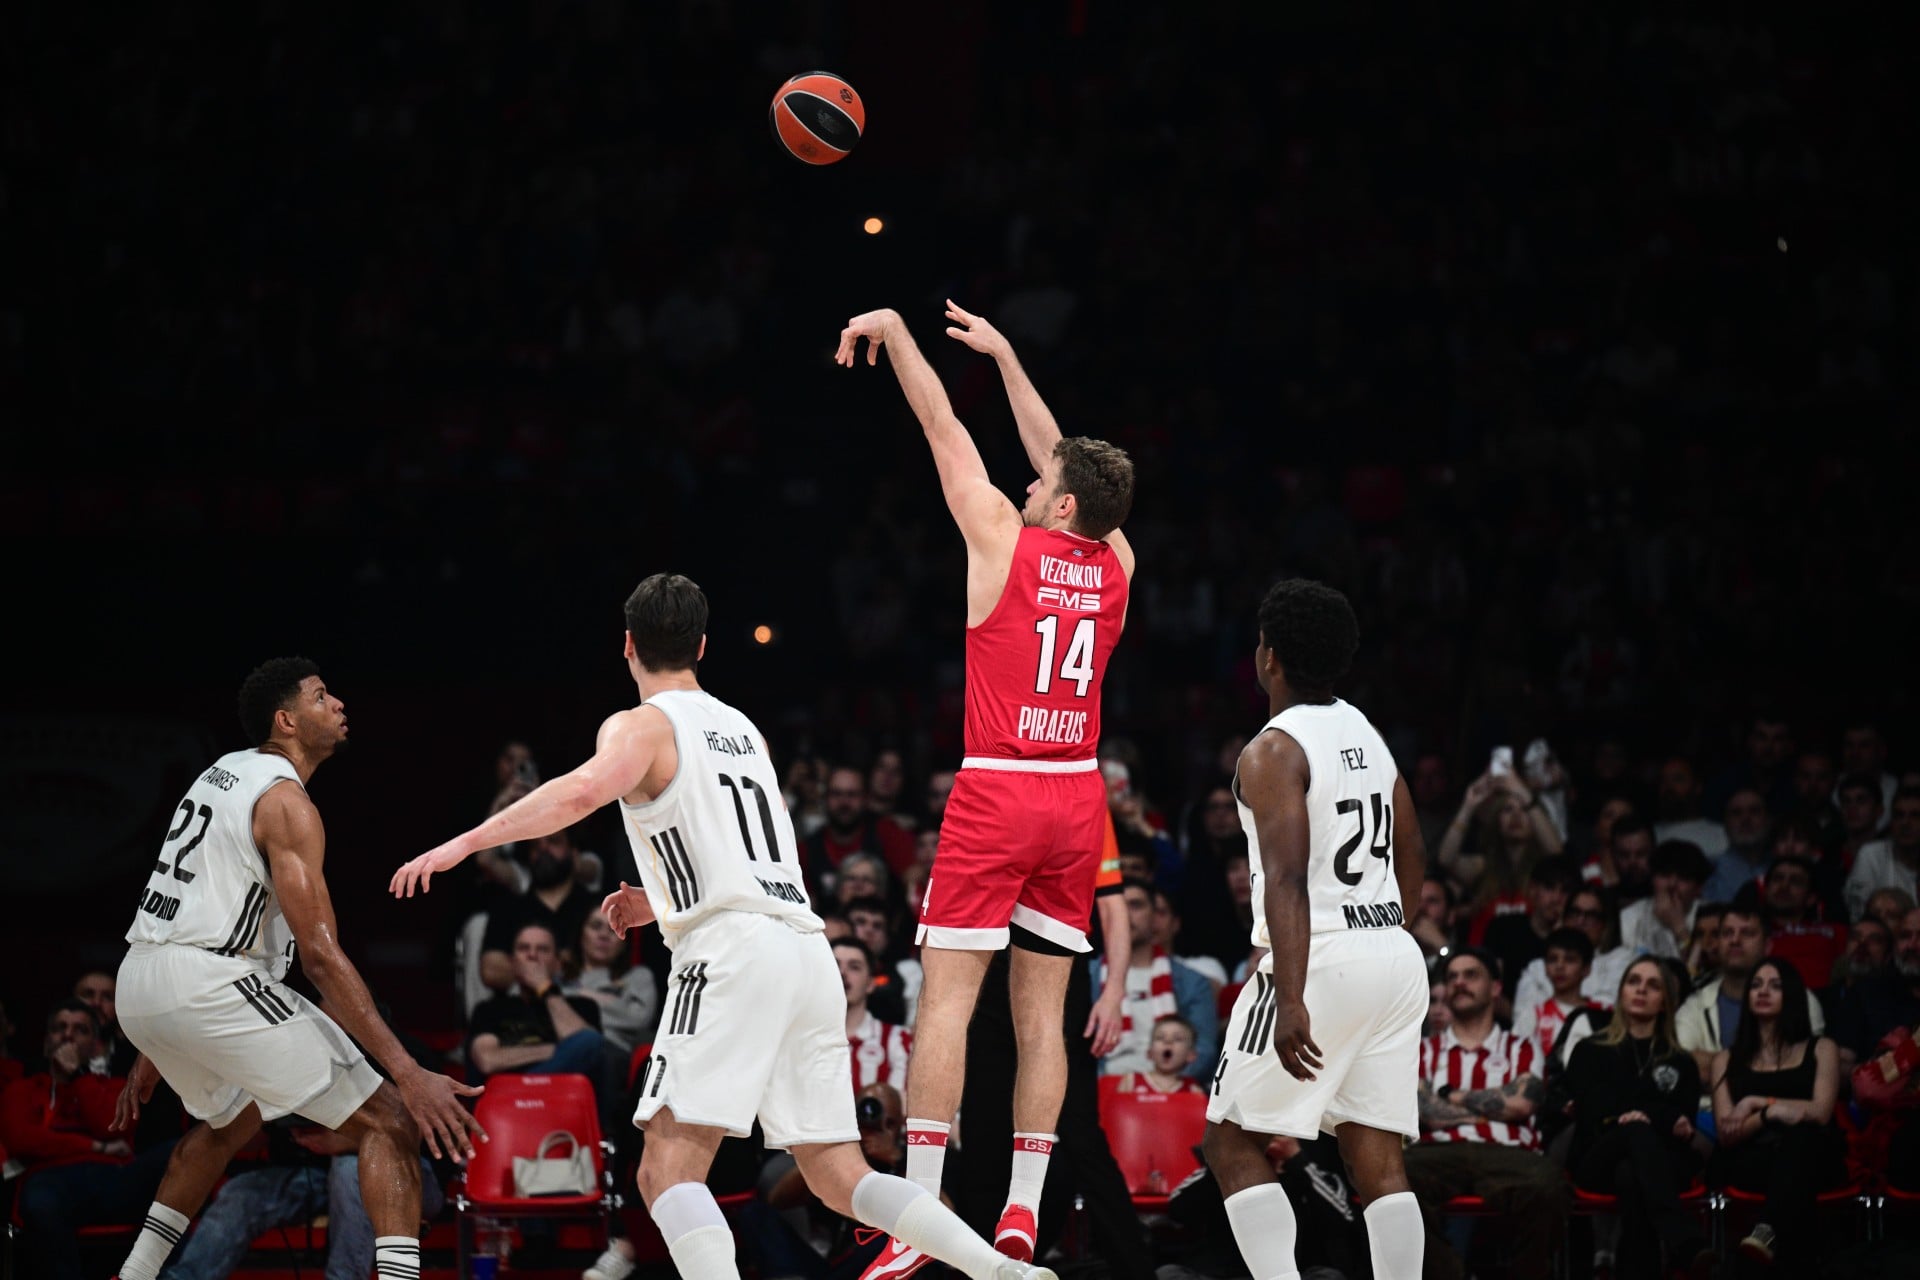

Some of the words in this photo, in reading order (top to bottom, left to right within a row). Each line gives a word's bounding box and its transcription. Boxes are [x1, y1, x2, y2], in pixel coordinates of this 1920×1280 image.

[1040, 554, 1102, 589] VEZENKOV
[1037, 586, 1101, 611] FMS
[1035, 614, 1097, 698] 14
[1018, 705, 1087, 744] PIRAEUS
[703, 730, 757, 757] HEZNJA
[718, 772, 782, 863] 11
[152, 798, 213, 885] 22
[1333, 792, 1392, 887] 24
[139, 887, 181, 922] ADRID
[1342, 901, 1403, 929] MADRID
